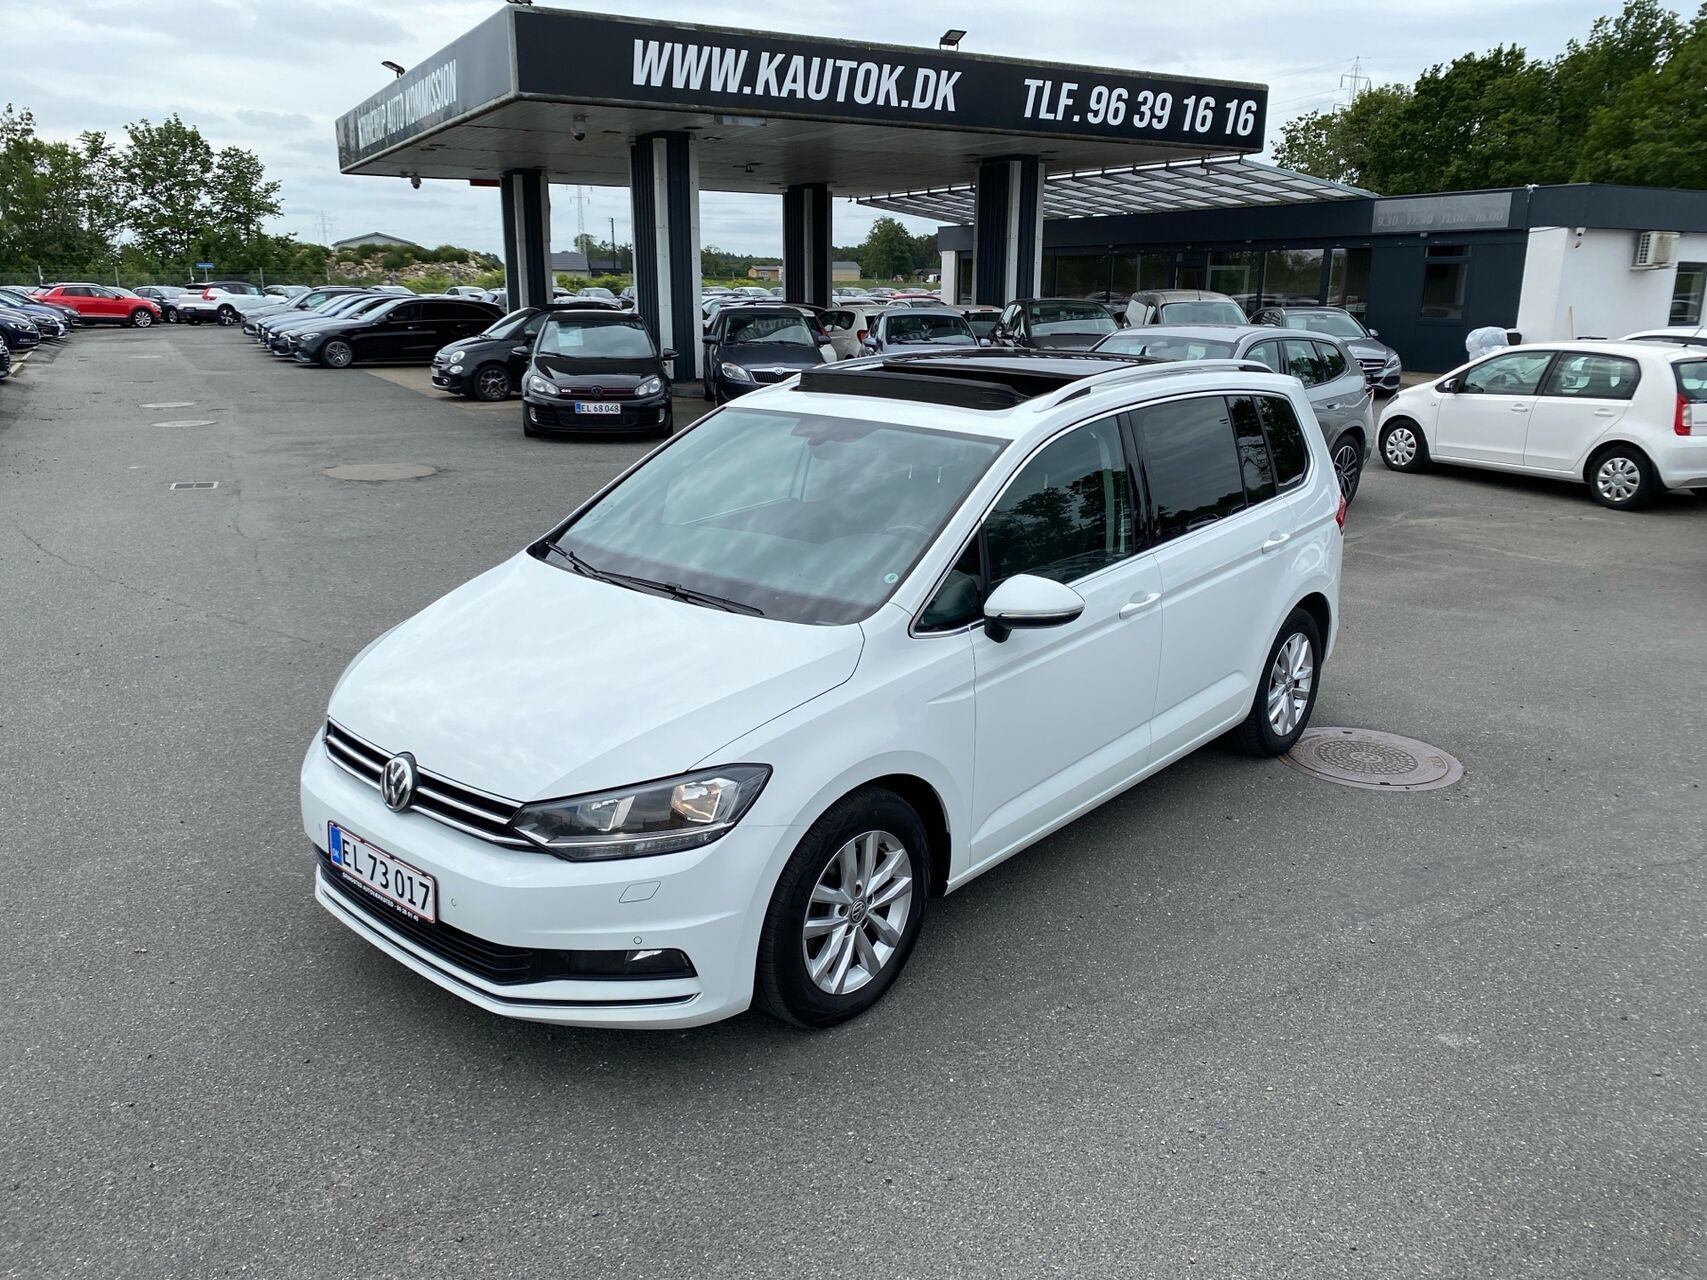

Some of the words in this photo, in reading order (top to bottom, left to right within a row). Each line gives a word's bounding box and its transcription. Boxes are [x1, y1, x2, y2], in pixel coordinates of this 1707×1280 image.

[387, 92, 404, 135] AUTO
[405, 58, 457, 126] KOMMISSION
[632, 39, 963, 112] WWW.KAUTOK.DK
[1024, 78, 1080, 122] TLF.
[1087, 85, 1129, 126] 96
[1133, 90, 1173, 130] 39
[1182, 95, 1216, 134] 16
[1224, 99, 1257, 137] 16
[581, 404, 591, 413] EL
[593, 404, 603, 413] 68
[604, 404, 620, 413] 048
[342, 838, 363, 875] EL
[367, 853, 390, 890] 73
[394, 869, 430, 910] 017
